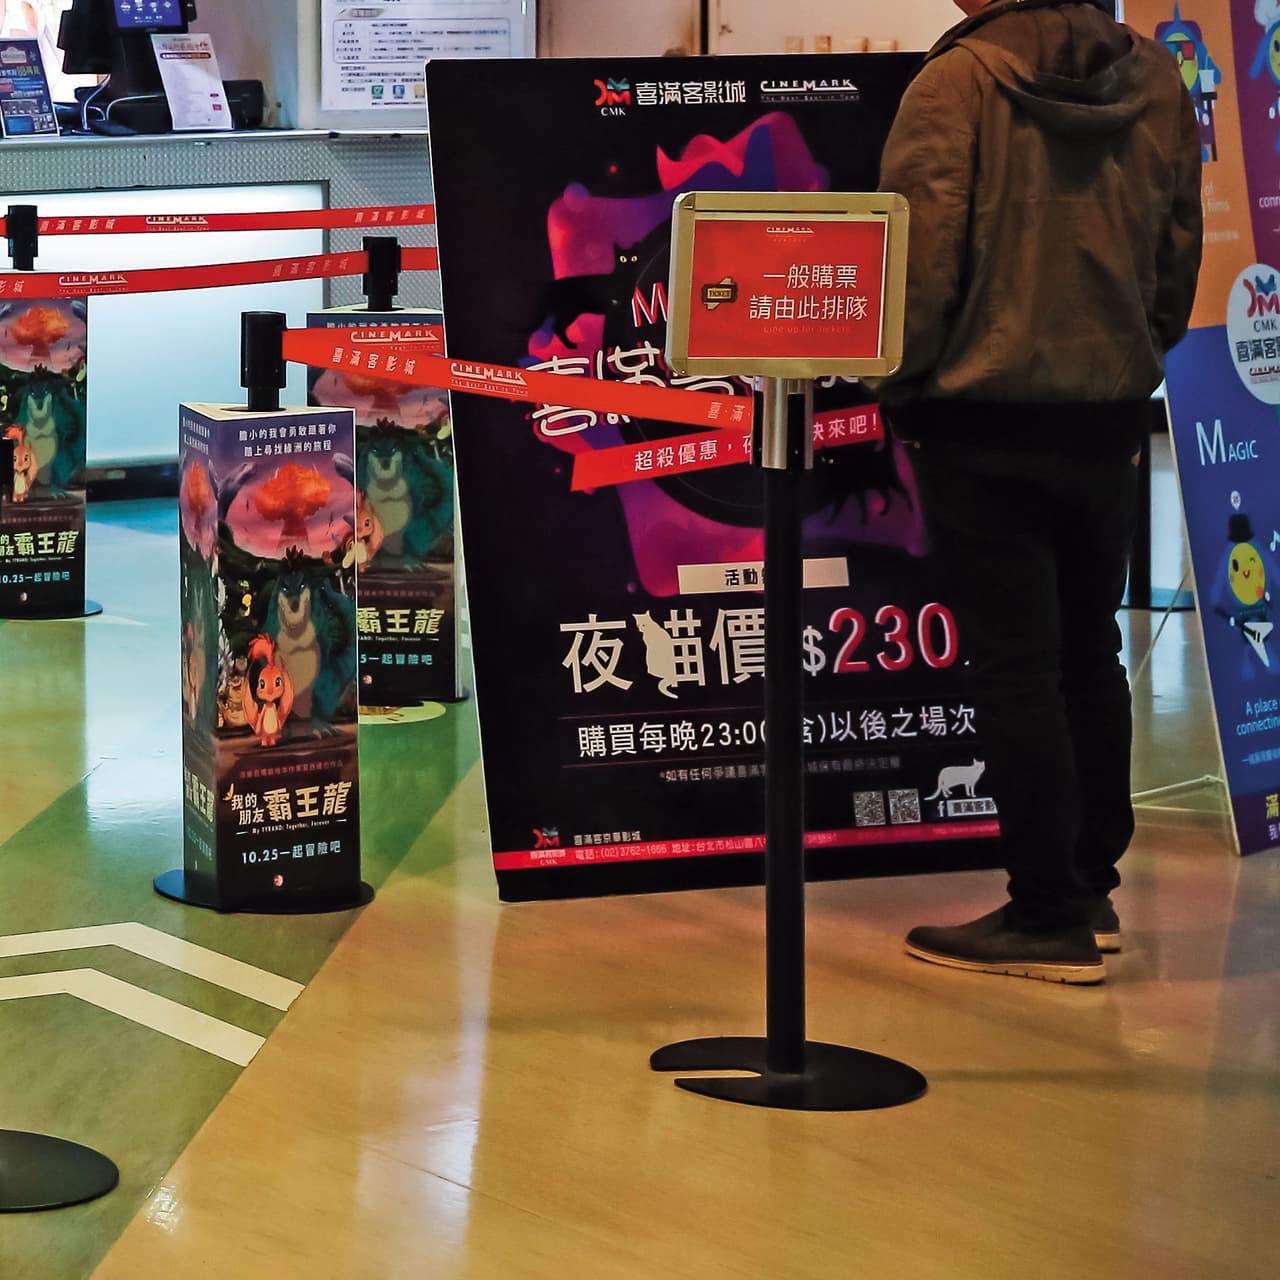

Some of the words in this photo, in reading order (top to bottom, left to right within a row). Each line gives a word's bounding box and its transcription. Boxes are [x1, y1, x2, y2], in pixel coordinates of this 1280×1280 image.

[635, 79, 747, 105] 喜滿客影城
[760, 79, 859, 92] CINEMARK
[600, 107, 627, 117] CMK
[145, 215, 209, 225] CINEMARK
[59, 272, 130, 287] CINEMARK
[763, 263, 858, 289] 一般購票
[749, 295, 868, 321] 請由此排隊
[1253, 318, 1278, 333] CMK
[350, 329, 439, 343] CINEMARK
[451, 362, 528, 386] CINEMARK
[1196, 419, 1260, 466] MAGIC
[13, 530, 79, 556] 霸王龍
[724, 567, 765, 587] 活動
[356, 607, 445, 634] 霸王龍
[803, 602, 959, 677] $230
[1254, 698, 1279, 718] place
[1236, 716, 1280, 736] connectin
[232, 792, 258, 811] 我的
[263, 781, 352, 822] 霸王龍
[239, 807, 265, 825] 朋友
[241, 840, 341, 865] 10.25一起冒險吧
